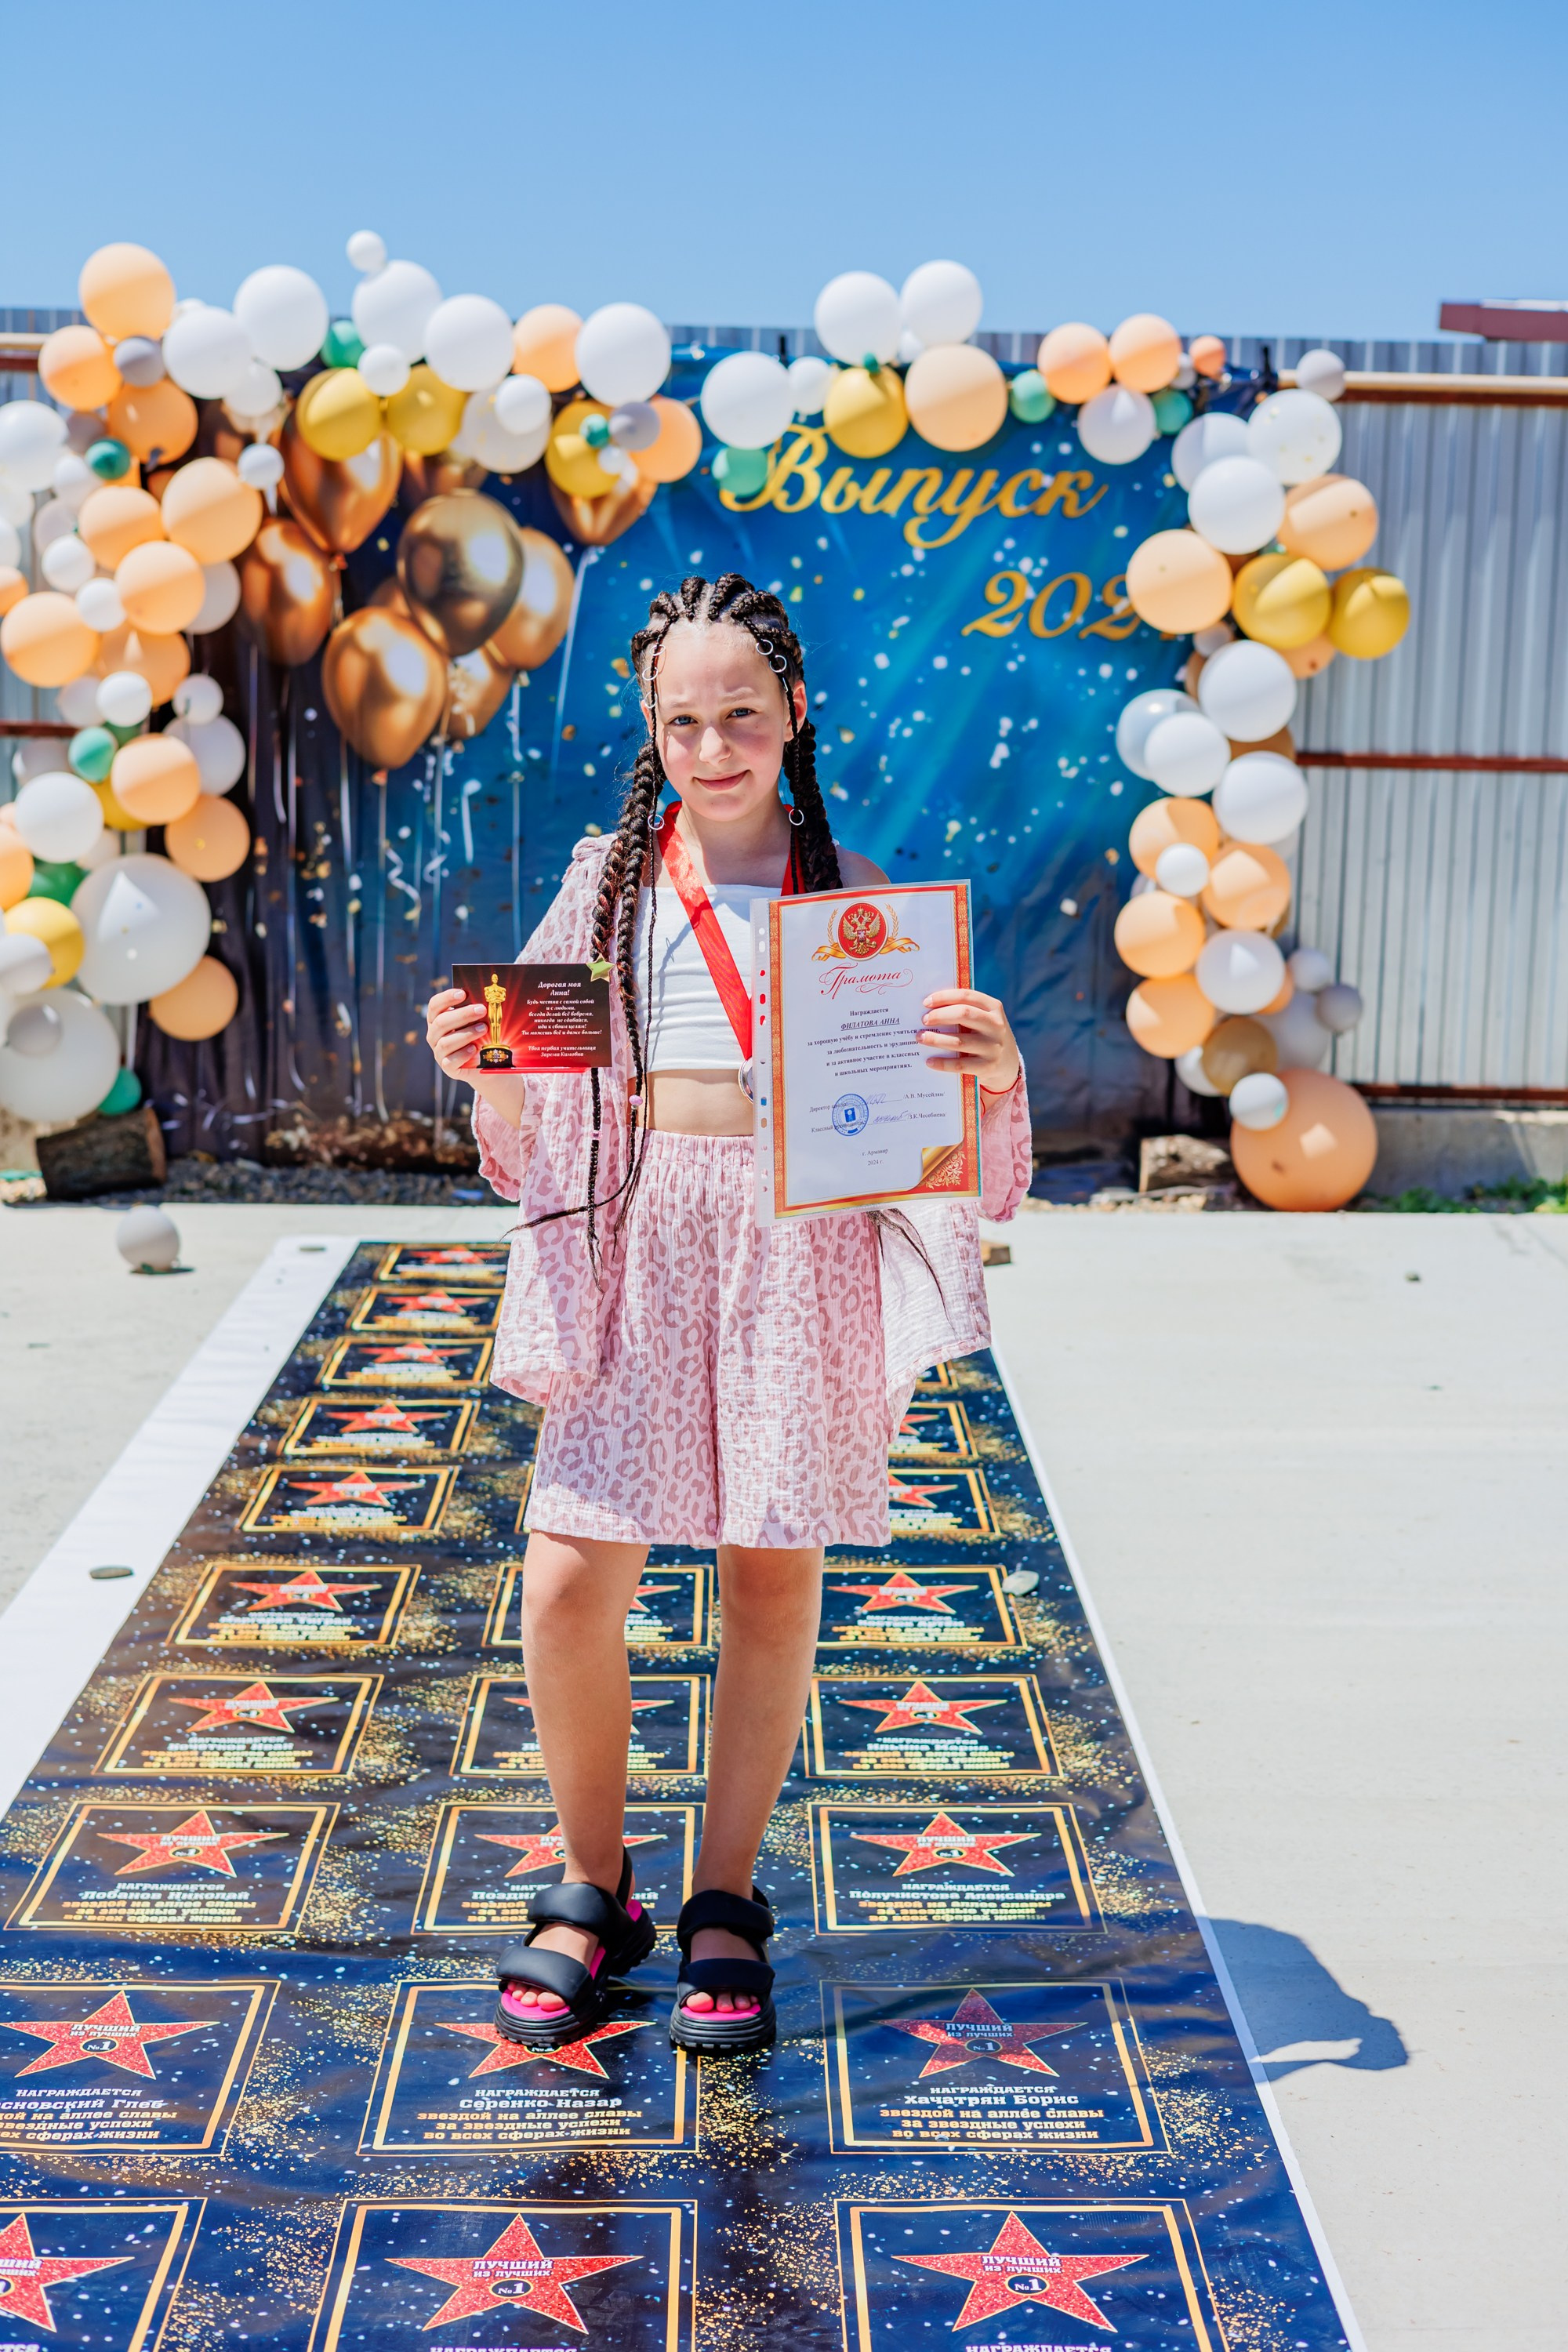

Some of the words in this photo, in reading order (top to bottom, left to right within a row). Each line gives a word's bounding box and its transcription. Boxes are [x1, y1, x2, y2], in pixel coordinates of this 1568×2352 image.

[719, 423, 1109, 549] Выпуск
[961, 570, 1176, 641] 202
[819, 962, 913, 1000] Грамота
[850, 1008, 889, 1017] Награждается
[840, 1020, 878, 1030] ФИЛАТОВА
[880, 1018, 900, 1026] АННА
[814, 1037, 839, 1046] хорошую
[839, 1034, 855, 1044] учёбу
[859, 1031, 891, 1040] стремление
[833, 1043, 883, 1054] любознательность
[889, 1040, 919, 1049] эрудицию
[840, 1068, 868, 1076] школьных
[869, 1063, 913, 1074] мероприятиях.
[809, 1104, 831, 1112] Директор
[71, 2024, 141, 2032] ЛУЧШИЙ
[945, 2023, 1013, 2032] ЛУЧШИЙ
[16, 2089, 143, 2097] НАГРАЖДАЕТСЯ
[475, 2089, 601, 2097] НАГРАЖДАЕТСЯ
[930, 2085, 1055, 2095] НАГРАЖДАЕТСЯ
[0, 2099, 106, 2109] сновский
[111, 2099, 164, 2109] Глеб
[459, 2099, 548, 2111] Серенко
[556, 2098, 622, 2110] Назар
[904, 2095, 1007, 2107] Хачатрян
[1014, 2095, 1079, 2107] Борис
[416, 2111, 492, 2122] звездой
[497, 2112, 520, 2121] на
[525, 2111, 579, 2120] аллее
[584, 2110, 642, 2118] славы
[880, 2109, 954, 2118] звездой
[959, 2110, 982, 2118] на
[987, 2110, 1040, 2118] аллее
[1046, 2109, 1104, 2118] славы
[89, 2120, 154, 2130] успехи
[463, 2121, 553, 2131] звездные
[557, 2118, 621, 2131] успехи
[902, 2120, 923, 2129] за
[928, 2120, 1018, 2129] звездные
[1022, 2120, 1086, 2131] успехи
[26, 2130, 93, 2141] сферах
[97, 2130, 160, 2139] жизни
[451, 2131, 492, 2140] всех
[499, 2129, 566, 2141] сферах
[571, 2126, 630, 2136] жизни
[966, 2129, 1034, 2140] сферах
[1038, 2130, 1098, 2139] жизни
[0, 2259, 42, 2269] ШИЙ
[473, 2259, 553, 2270] ЛУЧШИЙ
[982, 2256, 1062, 2267] ЛУЧШИЙ
[495, 2270, 550, 2278] лучших
[497, 2282, 524, 2294] №1
[1014, 2278, 1042, 2291] №1
